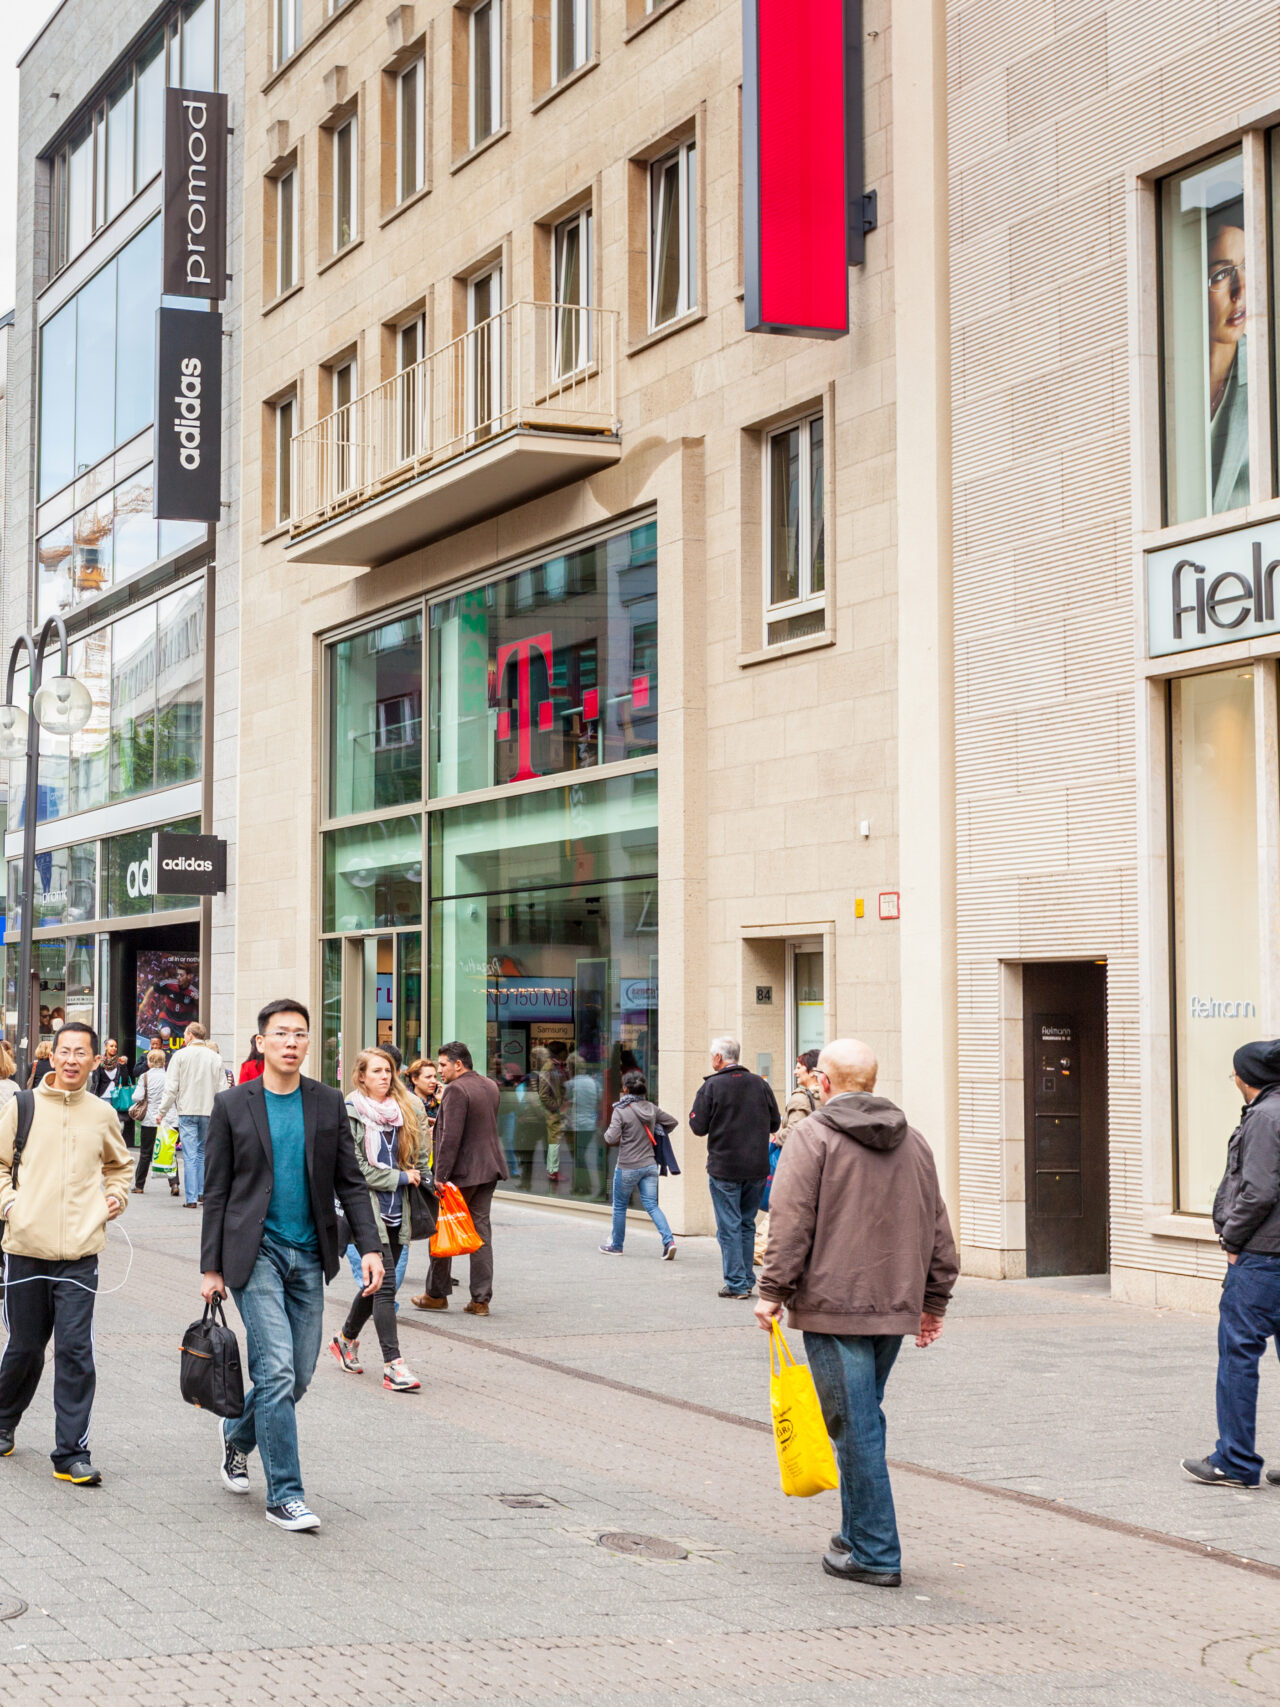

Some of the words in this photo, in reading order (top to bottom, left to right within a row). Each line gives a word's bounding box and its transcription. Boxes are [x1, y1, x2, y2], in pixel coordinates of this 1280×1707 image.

[182, 100, 211, 284] promod
[173, 357, 202, 471] adidas
[162, 856, 213, 872] adidas
[756, 989, 771, 1001] 84
[537, 1025, 568, 1034] Samsung
